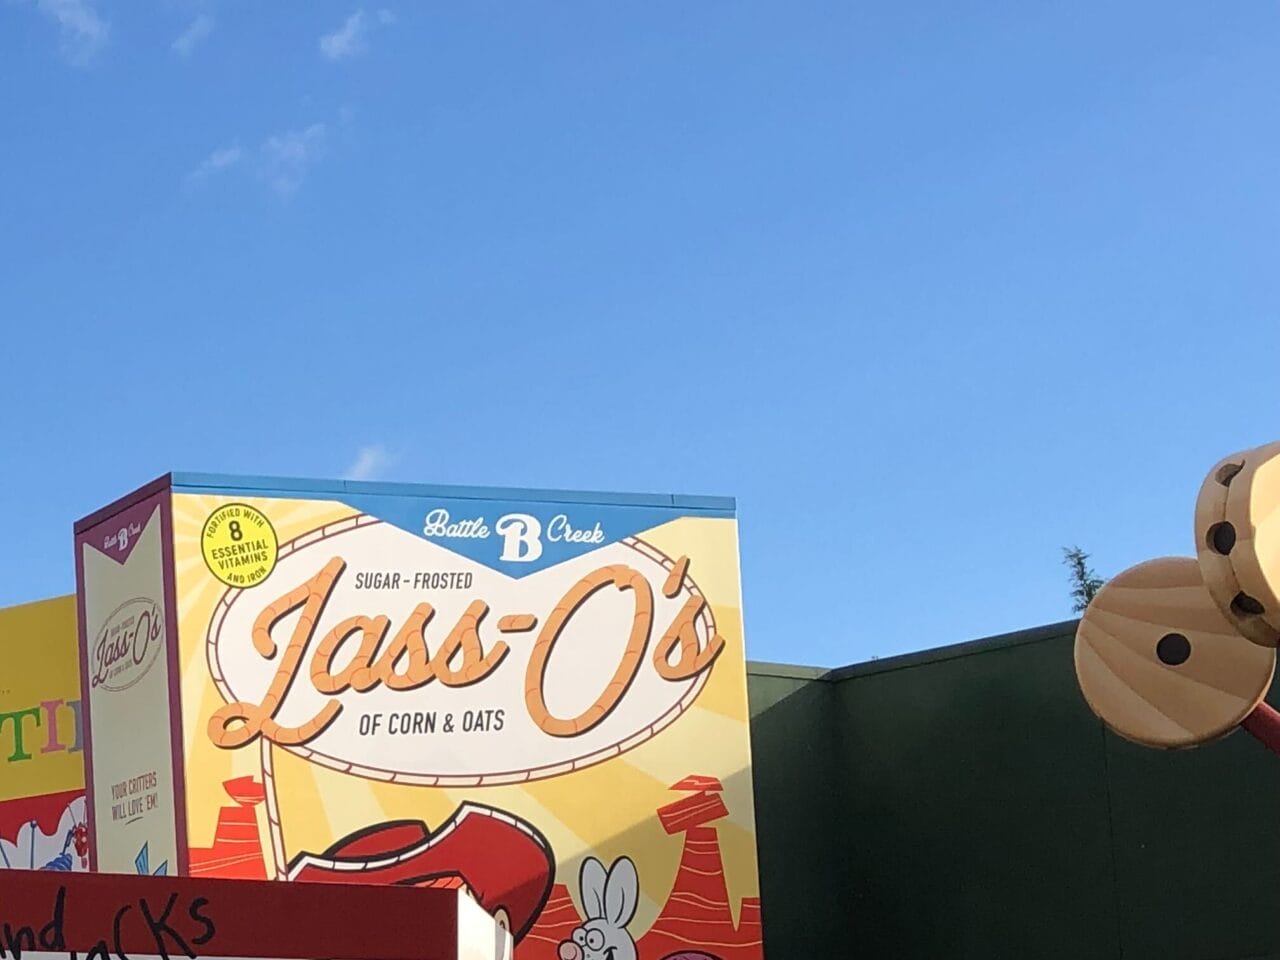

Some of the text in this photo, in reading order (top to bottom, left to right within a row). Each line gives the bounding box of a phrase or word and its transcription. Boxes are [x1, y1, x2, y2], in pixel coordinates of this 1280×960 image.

[207, 508, 265, 538] FORTIFIED WITH
[228, 520, 243, 541] 8
[423, 508, 605, 562] Battle B Creek
[211, 538, 269, 560] ESSENTIAL
[218, 550, 268, 570] VITAMINS
[226, 565, 267, 584] AND IRON
[359, 709, 505, 736] OF CORN & OATS
